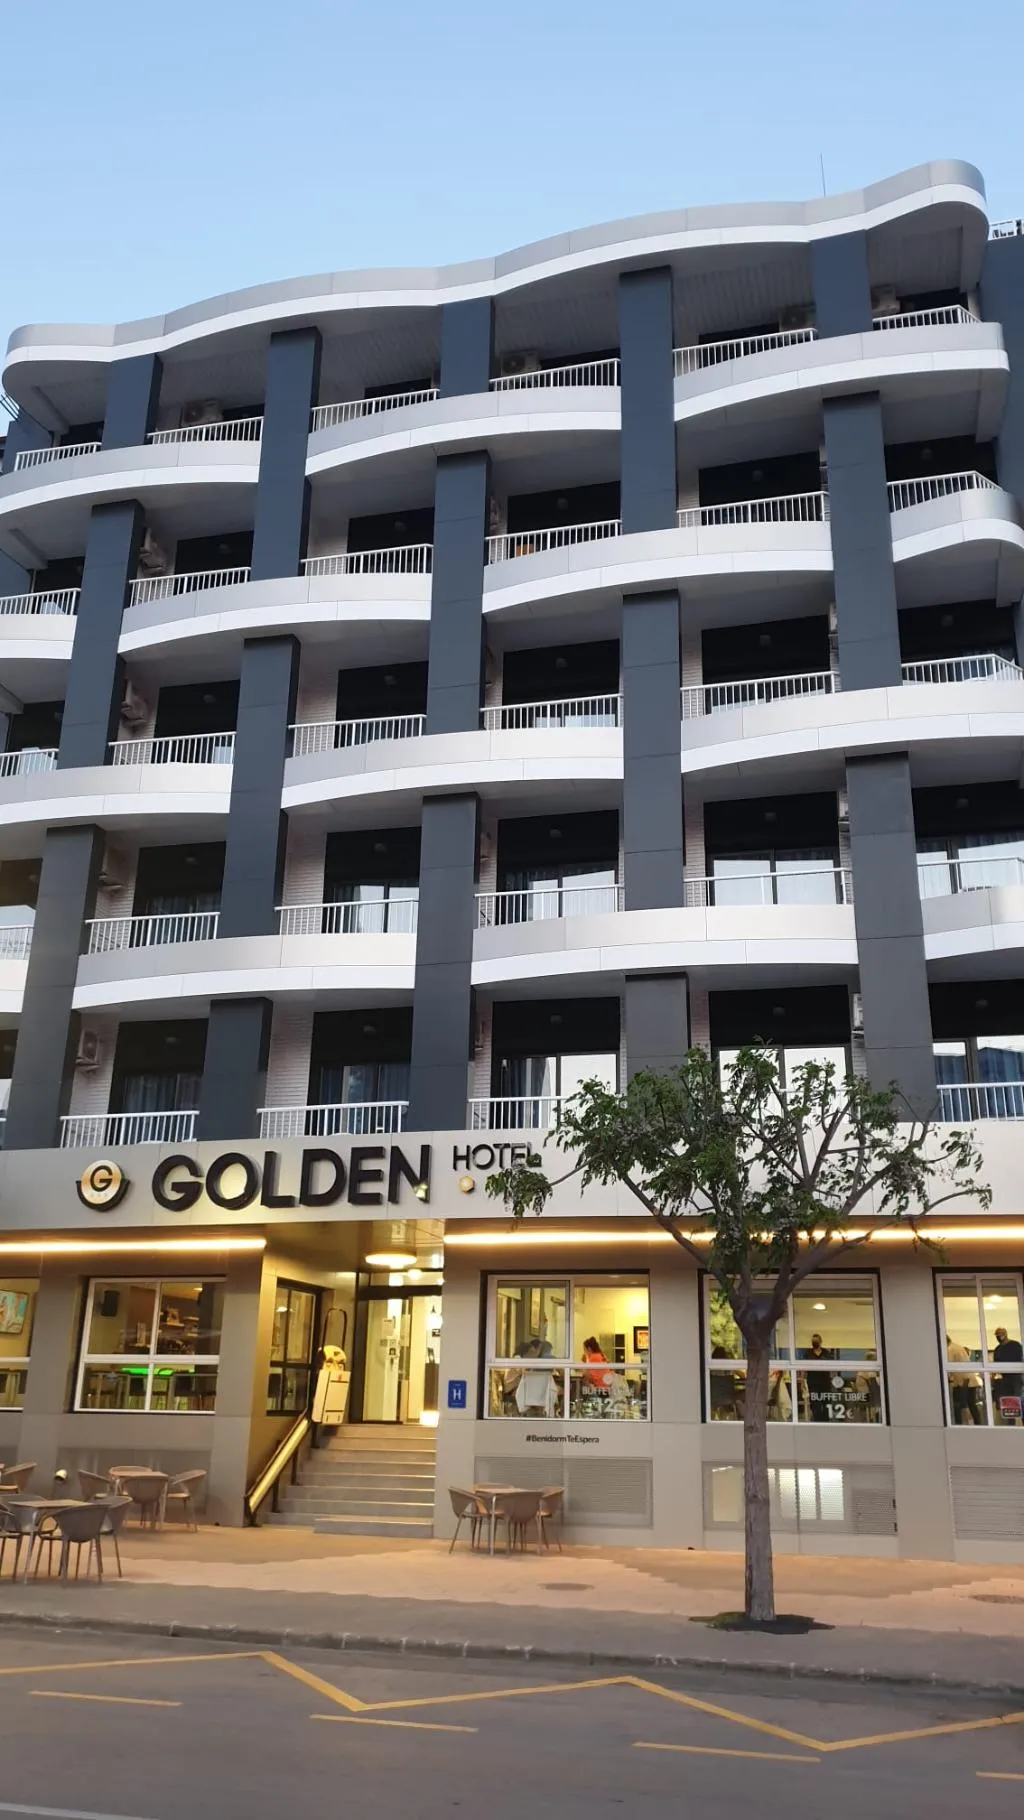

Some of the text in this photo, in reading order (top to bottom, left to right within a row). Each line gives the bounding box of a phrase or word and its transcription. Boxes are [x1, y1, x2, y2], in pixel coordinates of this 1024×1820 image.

[90, 1165, 113, 1192] G
[152, 1141, 542, 1212] GOLDEN HOTEL
[453, 1388, 461, 1401] H
[811, 1392, 867, 1402] BUFFET LIBRE
